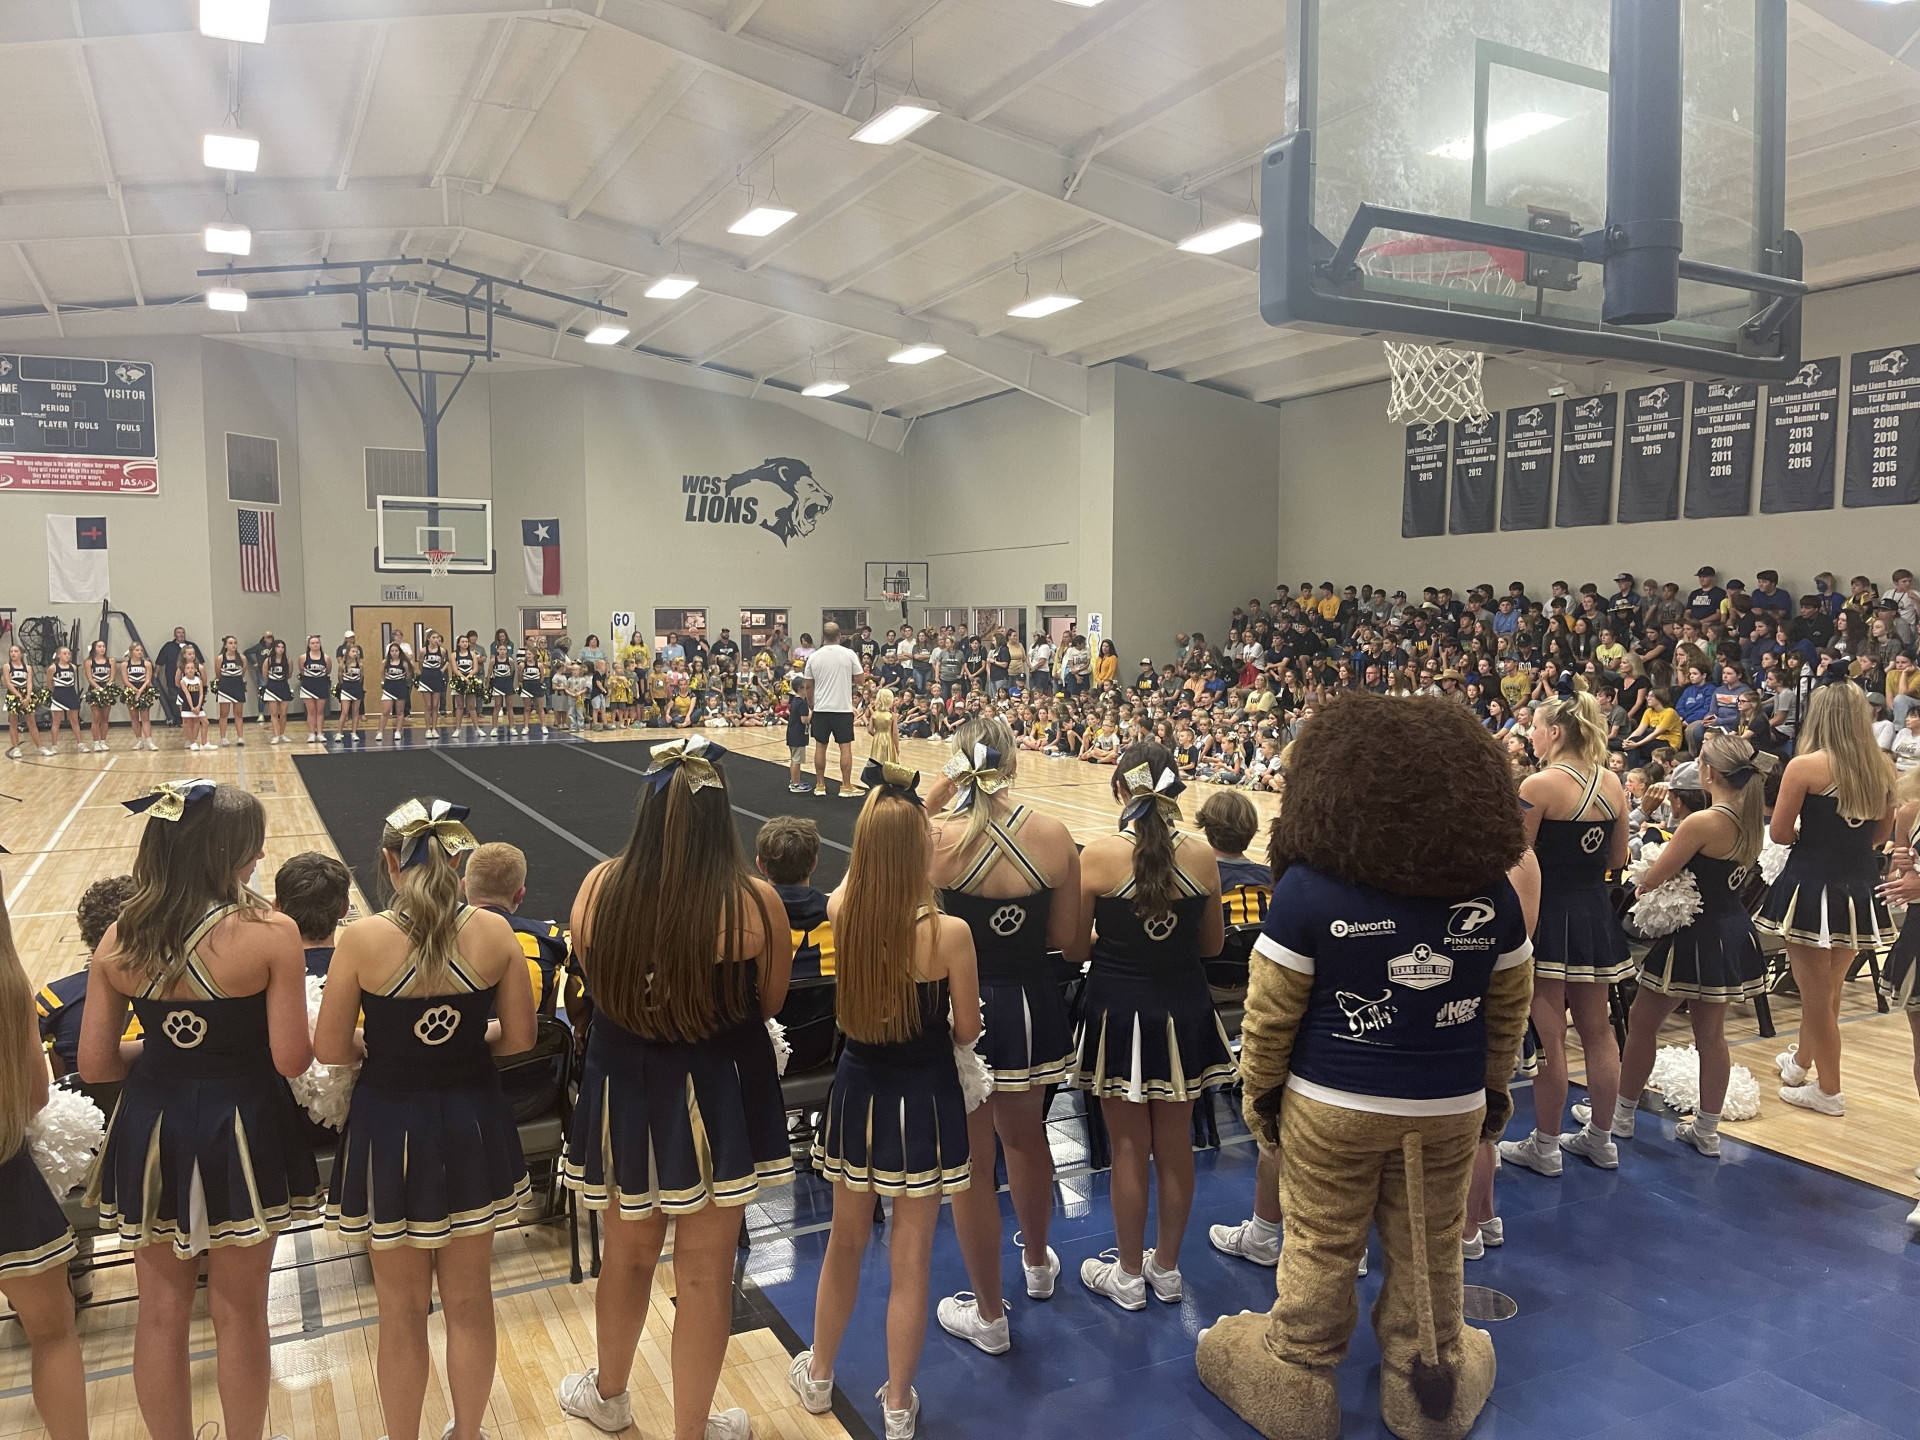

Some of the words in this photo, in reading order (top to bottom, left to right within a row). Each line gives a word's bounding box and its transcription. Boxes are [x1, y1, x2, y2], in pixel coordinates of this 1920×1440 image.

[51, 383, 76, 392] BONUS
[1853, 384, 1867, 392] Lady
[1869, 381, 1886, 390] Lions
[104, 389, 146, 400] VISITOR
[1803, 388, 1837, 399] Basketball
[1868, 393, 1885, 403] TCAF
[1887, 392, 1899, 400] DIV
[40, 404, 70, 412] PERIOD
[1724, 400, 1755, 410] Basketball
[1786, 405, 1801, 414] TCAF
[1802, 404, 1814, 412] DIV
[1853, 406, 1879, 416] District
[1710, 415, 1724, 424] TCAF
[1725, 413, 1736, 422] DIV
[1776, 417, 1792, 426] State
[1794, 414, 1819, 424] Runner
[1874, 416, 1899, 429] 2008
[38, 420, 68, 428] PLAYER
[74, 422, 99, 430] FOULS
[1638, 425, 1652, 433] TCAF
[1698, 427, 1712, 435] State
[1714, 423, 1750, 433] Champions
[1790, 426, 1813, 439] 2013
[1874, 430, 1898, 443] 2010
[1711, 436, 1733, 448] 2010
[1789, 442, 1812, 454] 2014
[1643, 444, 1661, 456] 2015
[1874, 445, 1897, 458] 2012
[1579, 454, 1595, 464] 2012
[1712, 450, 1731, 463] 2011
[1521, 461, 1536, 471] 2016
[1788, 457, 1812, 469] 2015
[1873, 460, 1897, 473] 2015
[1419, 472, 1432, 481] 2015
[1469, 468, 1482, 477] 2012
[1710, 465, 1732, 477] 2016
[682, 476, 722, 494] WCS
[1872, 475, 1896, 488] 2016
[685, 495, 758, 524] LIONS
[385, 591, 418, 600] CAFETERIA
[614, 613, 629, 626] GO
[1092, 615, 1100, 624] WE
[1330, 919, 1396, 938] Dalworth
[1393, 966, 1415, 976] TEXAS
[1416, 965, 1434, 975] STEEL
[1435, 966, 1450, 975] TECH
[1447, 996, 1481, 1021] HBS
[1435, 1020, 1455, 1028] REAL
[1456, 1011, 1477, 1025] ESTATE
